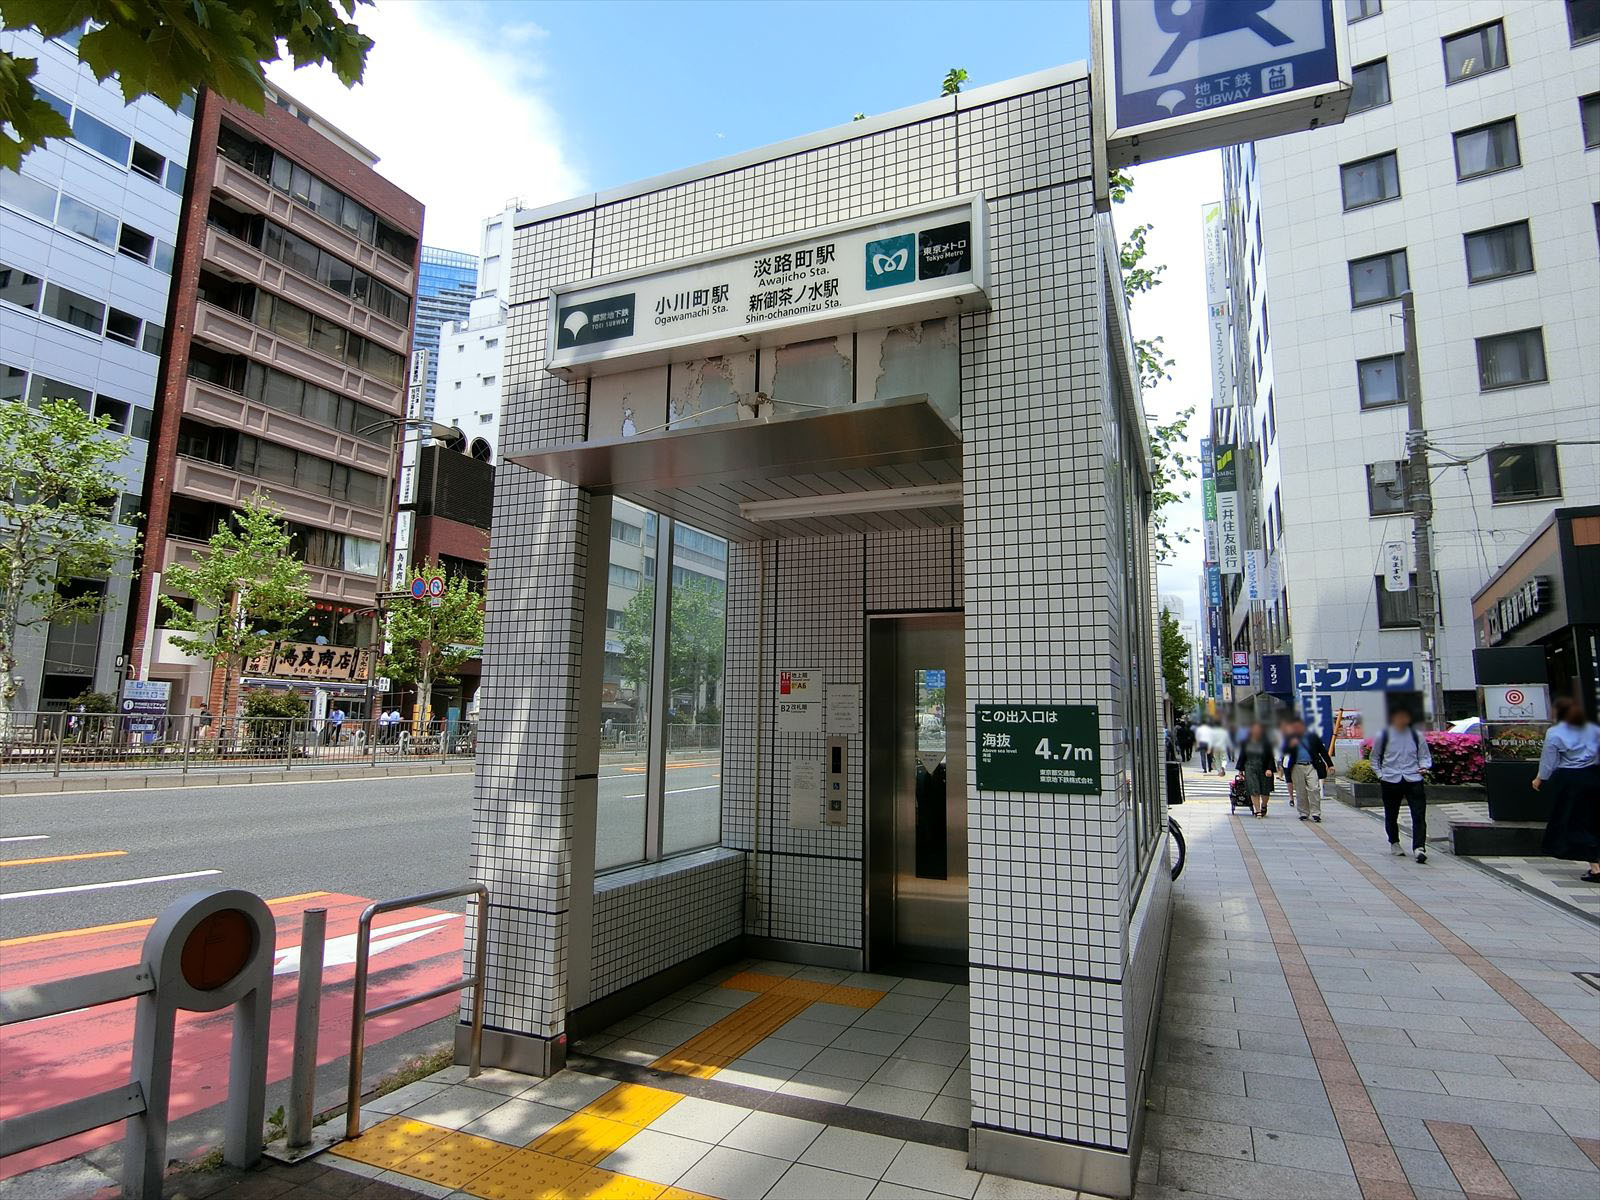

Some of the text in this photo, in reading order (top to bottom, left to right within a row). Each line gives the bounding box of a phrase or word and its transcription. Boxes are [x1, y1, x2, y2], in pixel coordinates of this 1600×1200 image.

[1194, 73, 1252, 96] 地下鉄
[1195, 87, 1251, 109] SUBWAY
[923, 240, 966, 256] 東京メトロ
[926, 250, 964, 262] Tokyo Metro
[753, 243, 836, 278] 淡路町駅
[758, 267, 829, 288] Awajicho Sta.
[655, 283, 729, 315] 小川町駅
[749, 278, 839, 313] 新御茶ノ水駅
[592, 308, 629, 322] 都営地下鉄
[654, 305, 729, 327] Ogawamachi Sta.
[745, 299, 842, 324] Shin-ochanomizu Sta.
[606, 318, 629, 328] SUBWAY
[1221, 497, 1238, 568] 三井住友銀行
[782, 672, 791, 680] 1F
[1298, 667, 1410, 687] エフワン
[780, 704, 791, 713] B2
[981, 710, 1058, 723] この出入口は
[982, 732, 1011, 748] 海抜
[1034, 737, 1093, 761] 4.7m
[1040, 769, 1075, 777] 東京都交通局
[1040, 775, 1094, 784] 東京地下鉄株式会社
